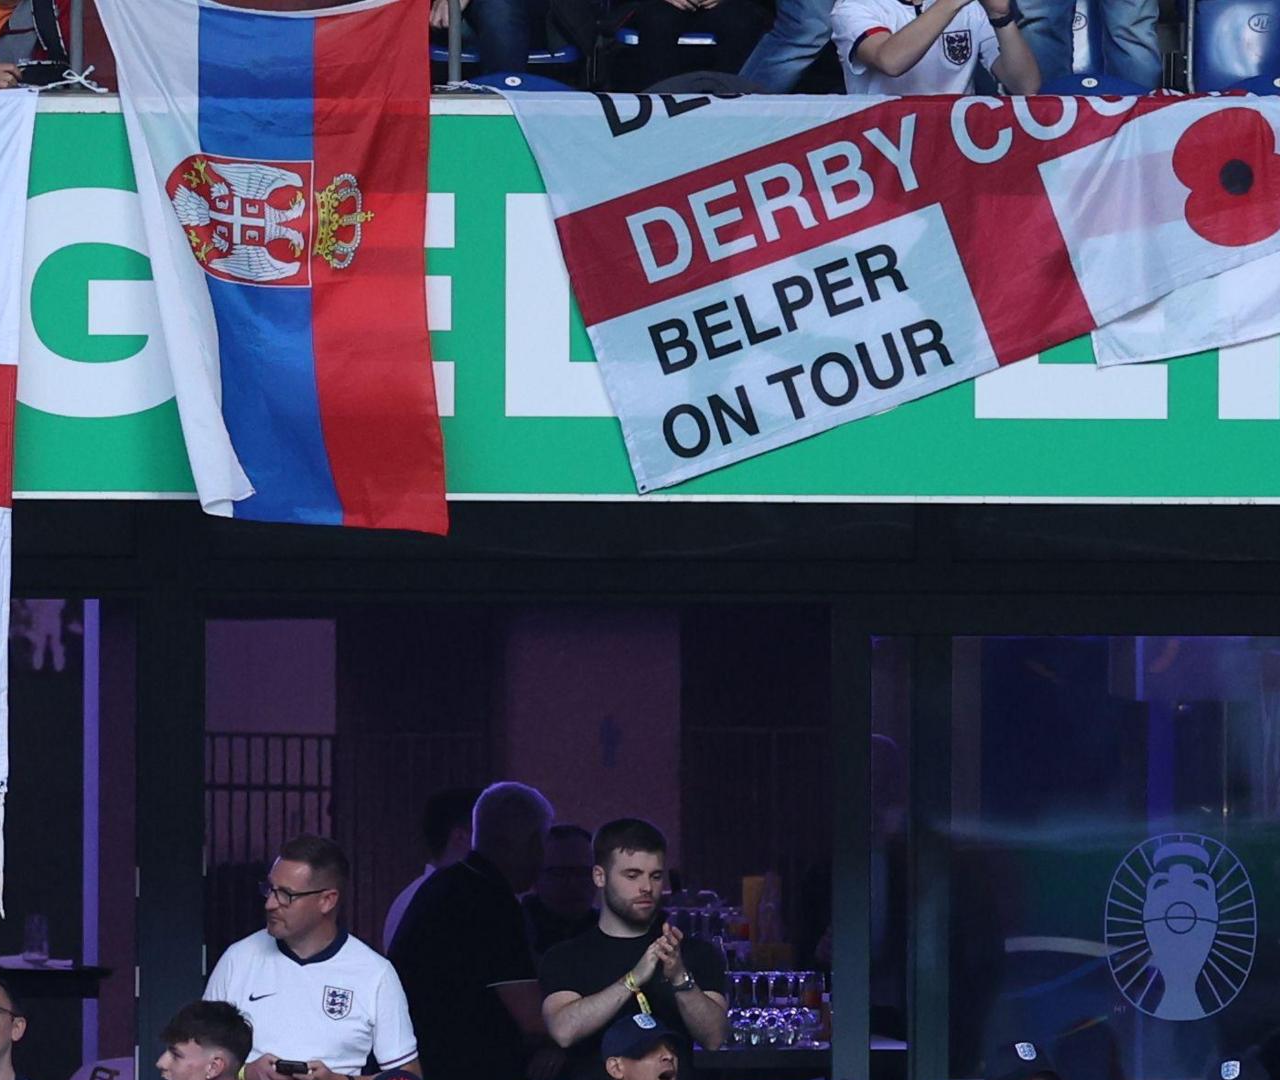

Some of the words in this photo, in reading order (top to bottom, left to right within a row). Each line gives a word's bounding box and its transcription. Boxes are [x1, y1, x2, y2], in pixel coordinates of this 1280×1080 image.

[625, 115, 919, 284] DERBY
[647, 243, 910, 375] BELPER
[661, 385, 761, 460] ON
[767, 318, 955, 420] TOUR
